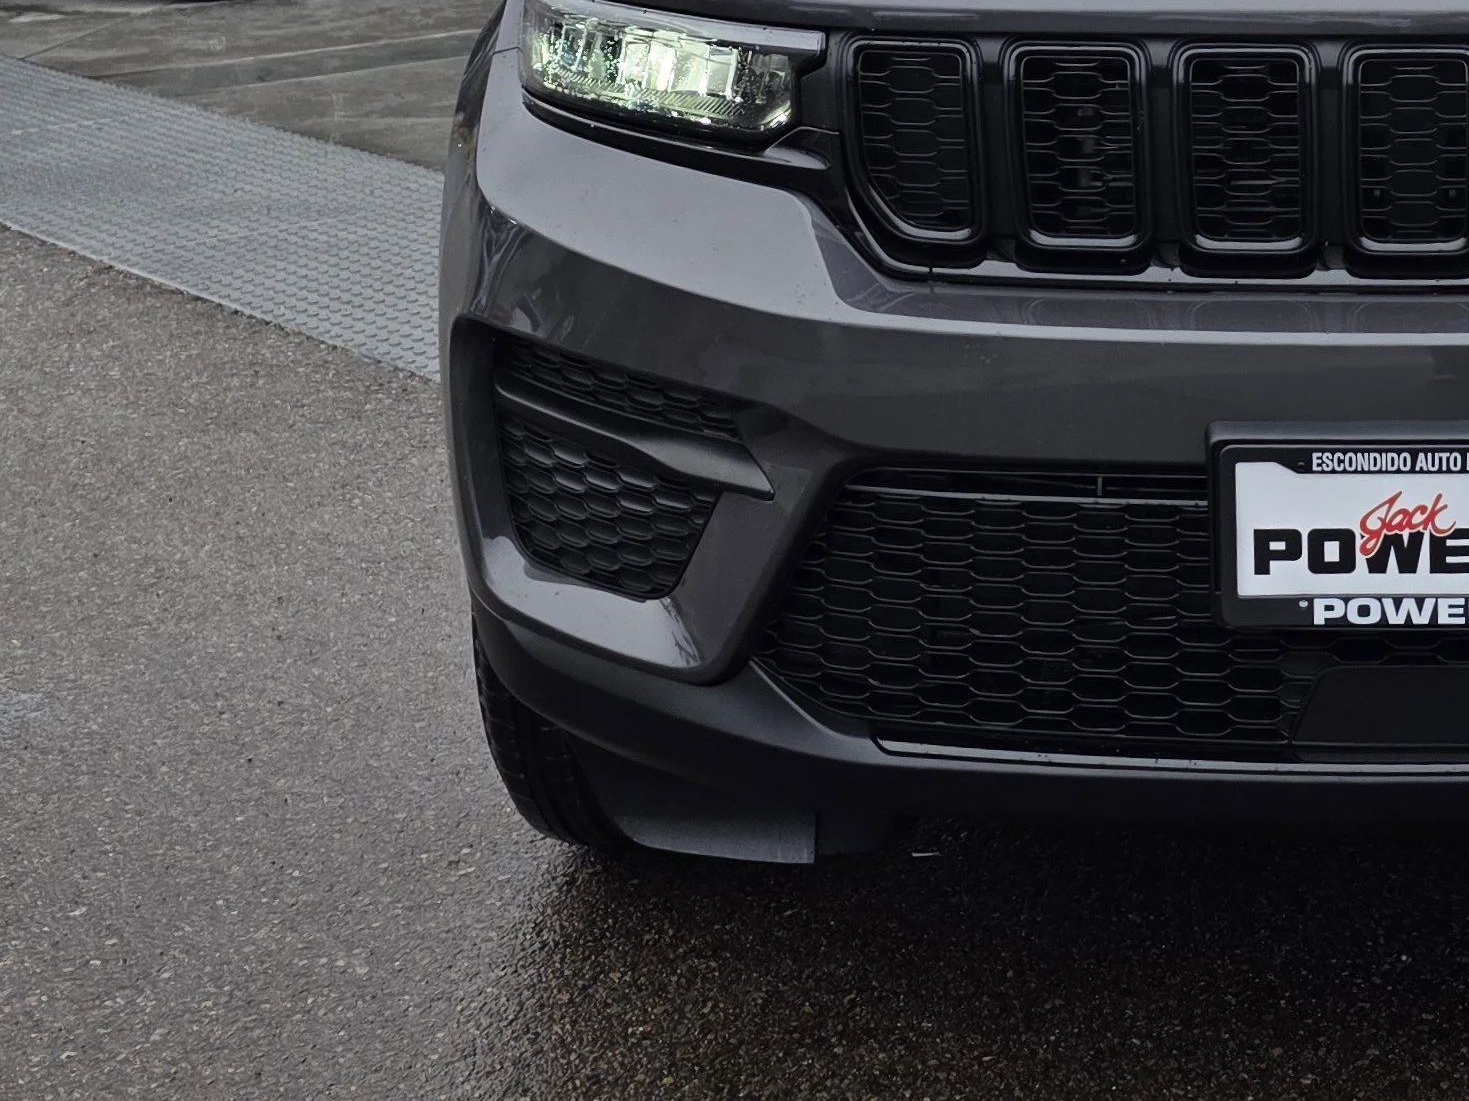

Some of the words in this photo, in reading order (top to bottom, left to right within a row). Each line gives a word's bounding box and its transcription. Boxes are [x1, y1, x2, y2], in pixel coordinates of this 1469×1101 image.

[1311, 452, 1412, 472] ESCONDIDO
[1414, 452, 1462, 472] AUTO
[1359, 491, 1457, 557] Jack
